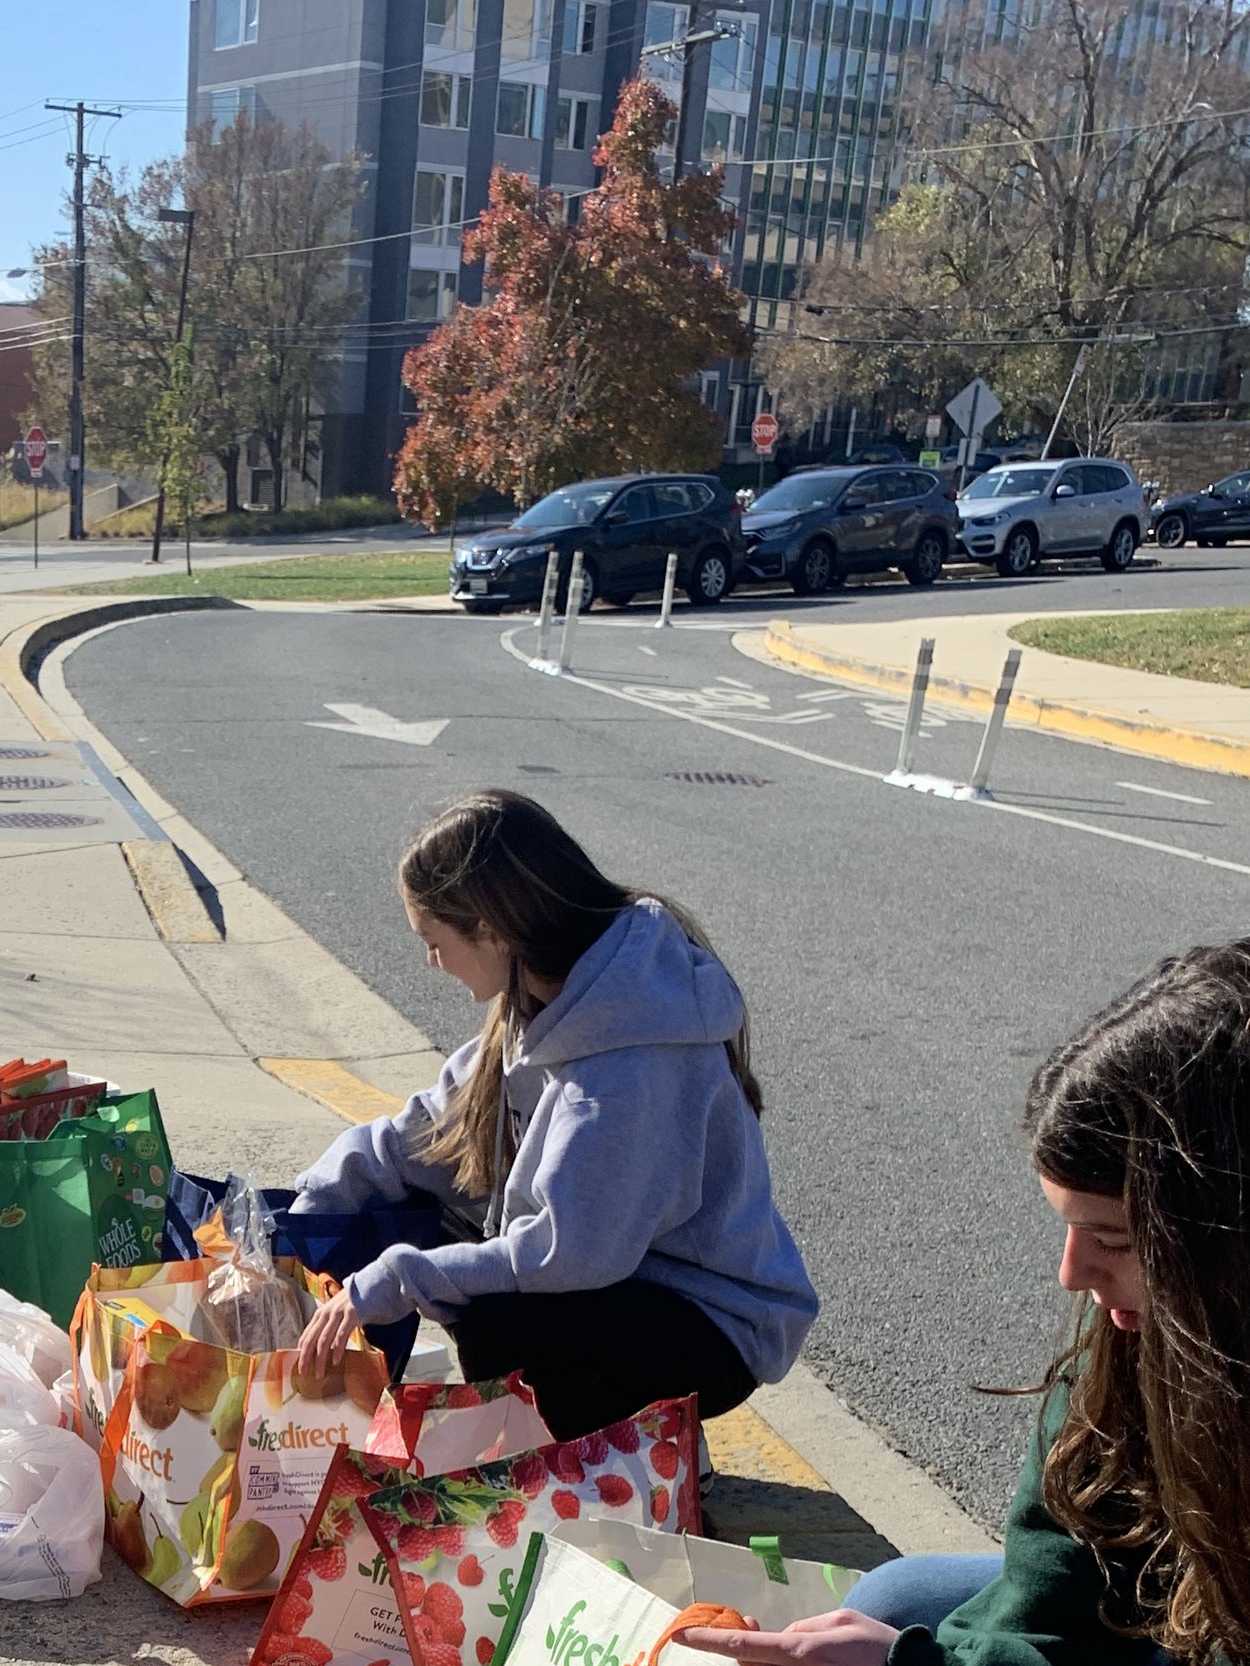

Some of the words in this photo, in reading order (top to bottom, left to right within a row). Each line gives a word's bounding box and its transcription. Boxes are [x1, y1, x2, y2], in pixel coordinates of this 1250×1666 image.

[753, 424, 778, 438] STOP
[26, 441, 47, 457] STOP
[99, 1218, 136, 1256] WHOLE
[106, 1239, 141, 1269] FOODS
[370, 1607, 392, 1620] GET
[373, 1621, 397, 1635] With
